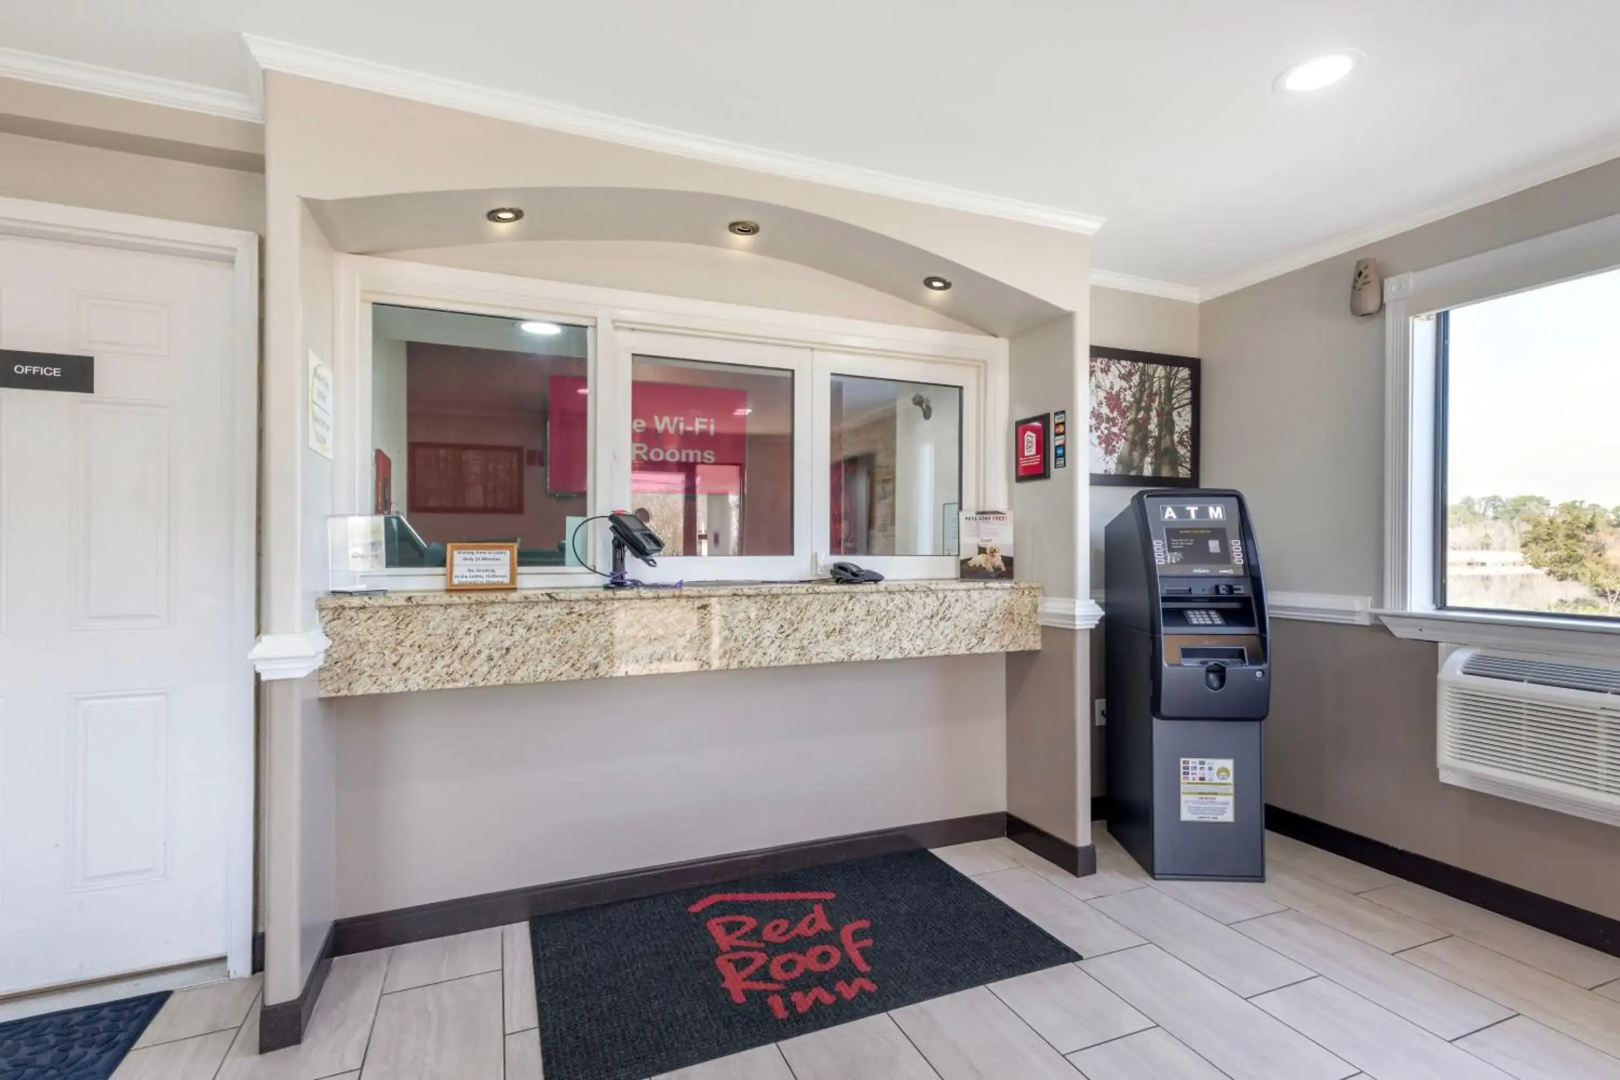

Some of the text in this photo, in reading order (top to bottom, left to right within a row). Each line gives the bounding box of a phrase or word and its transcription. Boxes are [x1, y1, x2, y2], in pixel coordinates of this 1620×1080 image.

[14, 364, 62, 377] OFFICE
[653, 415, 715, 436] Wi-Fi
[631, 442, 716, 463] Rooms
[706, 903, 833, 951] Red
[715, 918, 874, 1004] Roof
